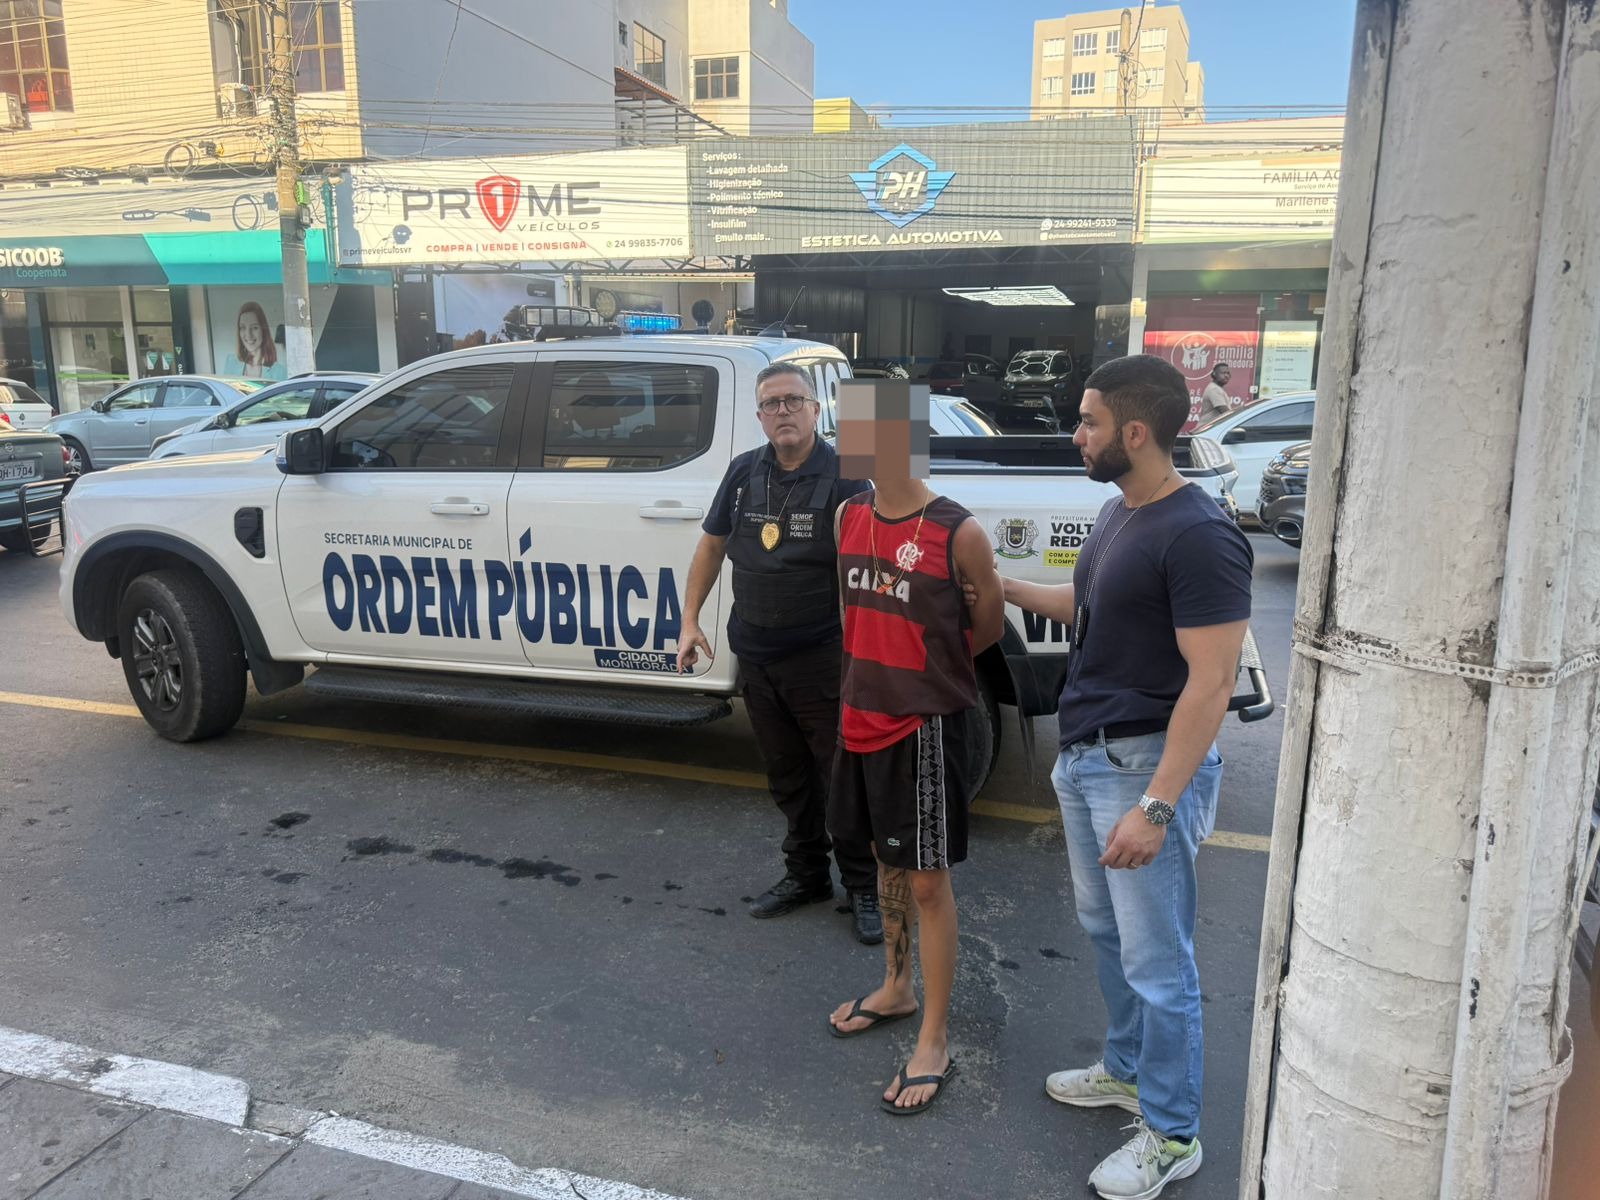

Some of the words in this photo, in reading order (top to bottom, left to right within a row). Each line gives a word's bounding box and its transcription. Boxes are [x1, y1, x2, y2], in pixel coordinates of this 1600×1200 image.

[702, 152, 742, 162] Serviços:
[747, 163, 788, 174] detalhada
[1263, 169, 1319, 184] FAMÍLIA
[877, 171, 927, 200] PH
[752, 190, 784, 200] técnico
[517, 221, 600, 232] VEÍCULOS
[1054, 219, 1065, 229] 24
[615, 240, 626, 248] 24
[628, 238, 683, 248] 99835-7706
[886, 230, 1004, 246] AUTOMOTIVA
[426, 244, 473, 253] COMPRA
[482, 243, 519, 252] VENDE
[528, 241, 587, 251] CONSIGNA
[0, 247, 64, 267] SICOOB
[324, 532, 390, 546] SECRETARIA
[393, 536, 455, 549] MUNICIPAL
[458, 538, 472, 549] DE
[323, 551, 480, 639] ORDEM
[484, 527, 683, 650] PÚBLICA
[618, 652, 667, 663] CIDADE
